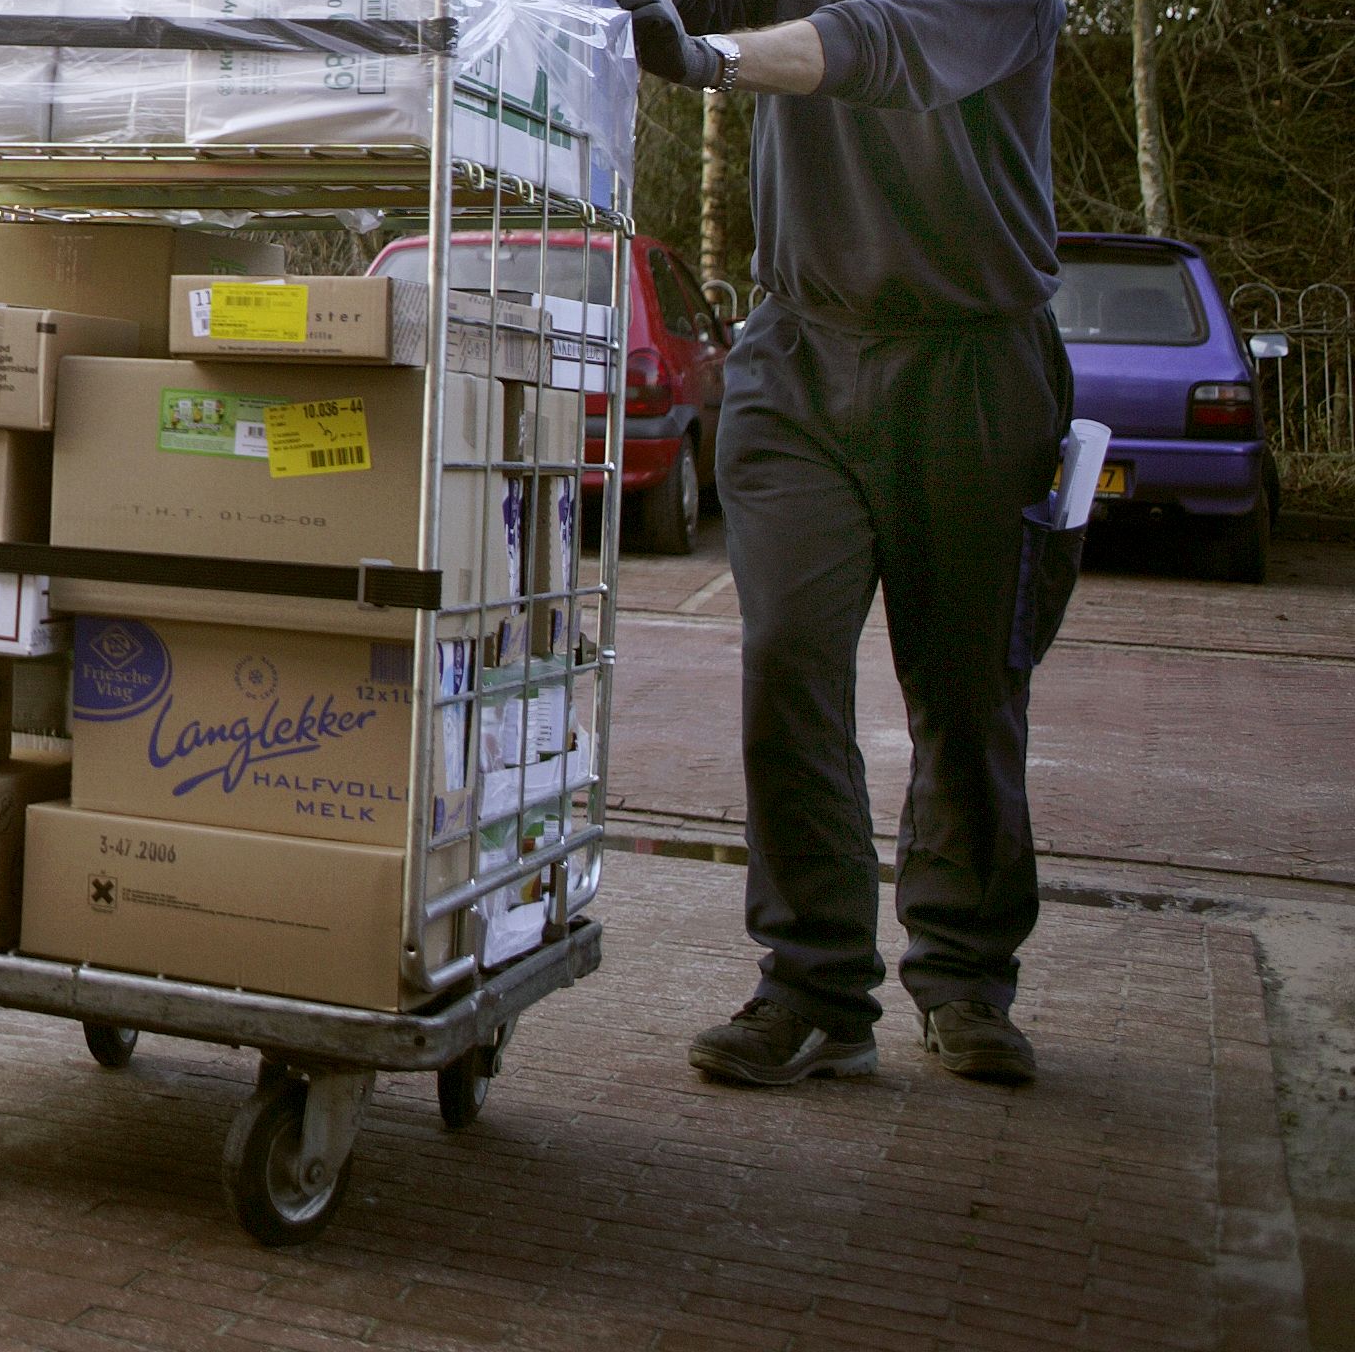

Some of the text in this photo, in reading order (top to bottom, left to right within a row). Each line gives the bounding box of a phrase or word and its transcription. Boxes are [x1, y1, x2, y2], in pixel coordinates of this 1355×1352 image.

[307, 310, 362, 323] ster
[219, 511, 327, 527] 01-02-08
[83, 663, 151, 686] Friesche
[94, 680, 133, 703] Vlag
[147, 693, 377, 798] Langlekker
[296, 800, 376, 823] MELK
